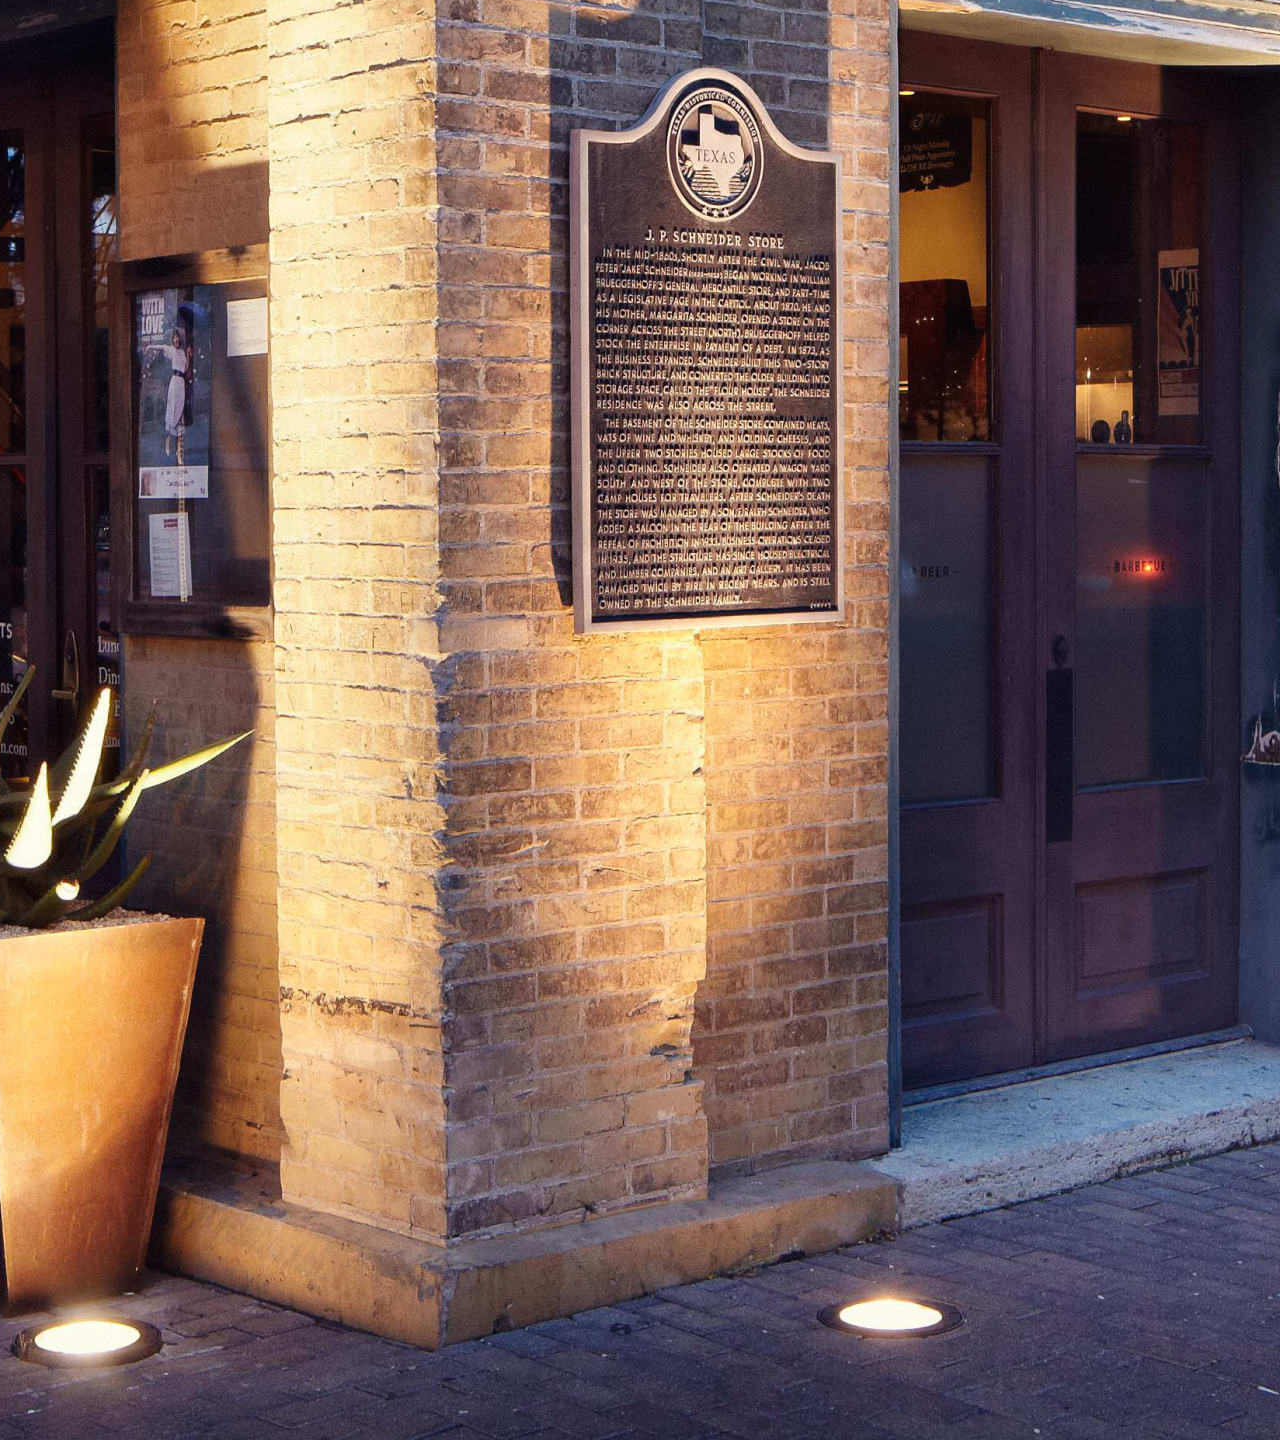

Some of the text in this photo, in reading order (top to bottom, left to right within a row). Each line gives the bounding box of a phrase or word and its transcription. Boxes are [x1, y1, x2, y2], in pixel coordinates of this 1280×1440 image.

[671, 91, 759, 144] TEXAS HISTORICAL COMMISSION
[695, 148, 736, 164] TEXAS
[644, 229, 785, 250] J. P. SCHNEIDER STORE
[602, 248, 612, 258] IN
[614, 249, 631, 259] THE
[718, 255, 740, 265] AFTER
[742, 257, 758, 266] THE
[760, 258, 780, 267] CIVIL
[782, 259, 802, 268] WAR,
[804, 260, 830, 270] JACOB
[595, 263, 617, 273] PETER
[644, 266, 687, 277] SCHNEIDER
[724, 270, 749, 280] BEGAN
[751, 272, 787, 282] WORKING
[789, 274, 798, 283] IN
[800, 274, 830, 284] WILLIAM
[665, 282, 699, 292] GENERAL
[701, 283, 746, 294] MERCANTILE
[748, 286, 773, 295] STORE,
[775, 287, 790, 296] AND
[792, 288, 830, 298] PART-TIME
[141, 297, 165, 315] WITH
[595, 293, 607, 302] AS
[609, 294, 616, 303] A
[618, 294, 667, 305] LEGISLATIVE
[669, 296, 688, 306] PAGE
[691, 297, 699, 306] IN
[702, 298, 715, 307] THE
[753, 300, 779, 310] ABOUT
[802, 303, 812, 311] HE
[814, 303, 830, 312] AND
[141, 315, 164, 335] LOVE
[595, 308, 610, 318] HIS
[612, 309, 647, 319] MOTHER,
[696, 312, 736, 322] SCHNEIDER,
[739, 314, 770, 324] OPENED
[772, 315, 777, 324] A
[779, 316, 800, 325] STORE
[802, 317, 814, 326] ON
[816, 317, 830, 326] THE
[595, 323, 628, 333] CORNER
[631, 325, 661, 335] ACROSS
[663, 326, 678, 335] THE
[680, 327, 706, 336] STREET
[803, 331, 830, 340] HELPED
[595, 339, 623, 349] STOCK
[625, 340, 641, 349] THE
[693, 342, 702, 351] IN
[705, 343, 739, 352] PAYMENT
[741, 344, 752, 353] OF
[755, 344, 761, 353] A
[787, 345, 796, 354] IN
[798, 346, 817, 355] 1873,
[819, 346, 830, 355] AS
[596, 354, 612, 363] THE
[614, 355, 652, 364] BUSINESS
[697, 357, 739, 367] SCHNEIDER
[741, 358, 761, 367] BUILT
[763, 359, 780, 368] THIS
[783, 359, 830, 369] TWO-STORY
[596, 369, 620, 378] BRICK
[668, 371, 686, 380] AND
[734, 372, 748, 381] THE
[751, 373, 774, 382] OLDER
[776, 373, 810, 382] BUILDING
[812, 374, 830, 383] INTO
[596, 384, 632, 393] STORAGE
[661, 385, 692, 395] CALLED
[694, 386, 708, 395] THE
[774, 388, 787, 396] THE
[789, 388, 830, 397] SCHNEIDER
[596, 400, 641, 409] RESIDENCE
[666, 401, 689, 410] ALSO
[692, 401, 724, 410] ACROSS
[727, 402, 743, 410] THE
[920, 566, 949, 578] BEER
